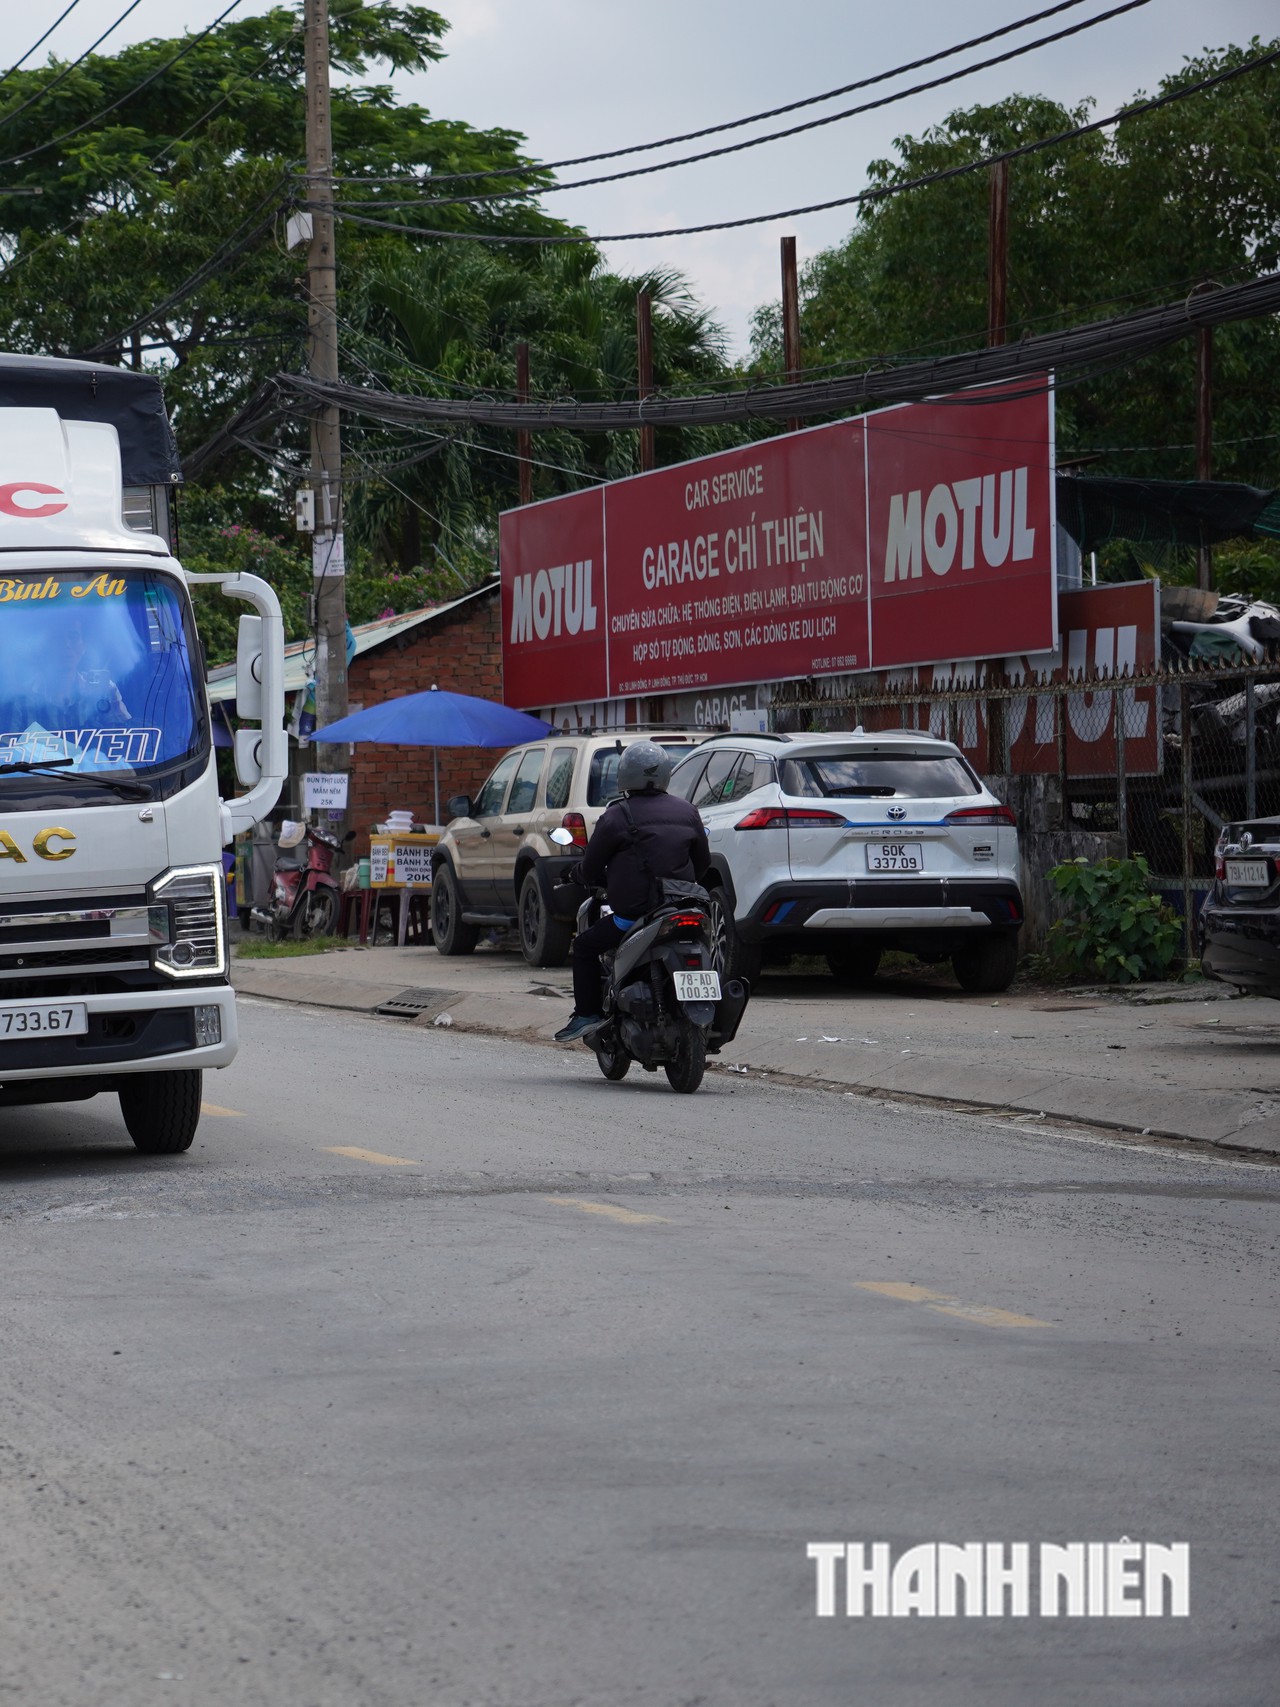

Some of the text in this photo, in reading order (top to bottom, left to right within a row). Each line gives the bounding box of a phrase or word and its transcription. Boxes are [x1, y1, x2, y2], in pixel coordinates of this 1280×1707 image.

[685, 464, 764, 511] CAR SERVICE
[884, 466, 1035, 583] MOTUL
[642, 506, 824, 591] GARAGE CHÍ THIỆN
[71, 573, 128, 598] An
[510, 559, 597, 645] MOTUL
[611, 573, 863, 633] CHUYÊN SỬA CHỮA: HỆ THỐNG ĐIỆN, ĐIỆN LẠNH, ĐẠI TU ĐỘNG CƠ
[633, 641, 648, 665] HỘP
[649, 637, 660, 660] SỐ
[744, 622, 761, 647] CÁC
[763, 619, 787, 644] DÒNG
[789, 621, 800, 640] XE
[802, 619, 814, 639] DU
[816, 616, 836, 641] LỊCH
[396, 846, 422, 856] BÁNH
[882, 845, 906, 857] 60K
[396, 857, 421, 866] BÁNH
[874, 857, 917, 869] 337.09
[406, 873, 431, 881] 20K
[680, 974, 712, 986] 78-AD
[680, 986, 717, 998] 100.33
